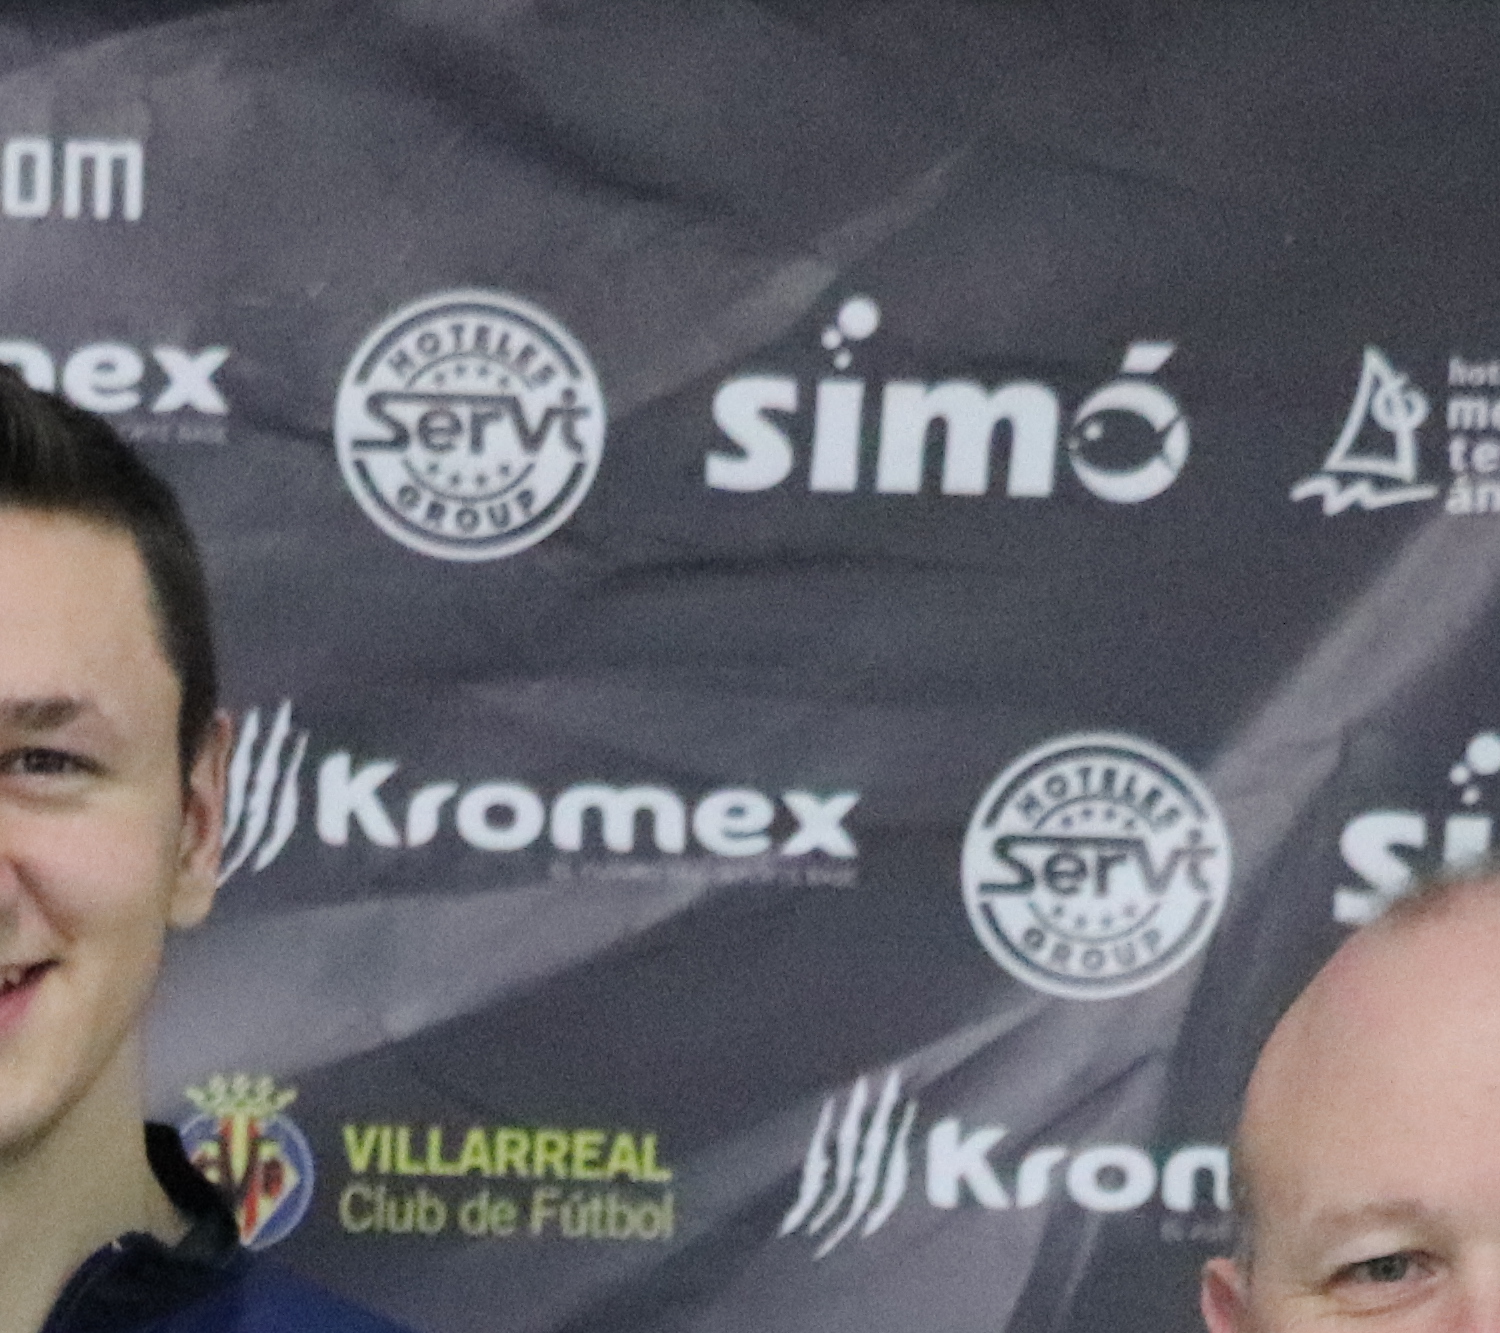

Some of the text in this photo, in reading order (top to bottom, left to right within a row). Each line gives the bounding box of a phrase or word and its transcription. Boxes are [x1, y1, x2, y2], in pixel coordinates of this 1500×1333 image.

[394, 482, 539, 536] GROUP
[313, 751, 863, 860] Kromex
[1021, 923, 1166, 976] GROUP
[342, 1123, 672, 1183] VILLARREAL
[339, 1185, 675, 1242] Club de Fútbol
